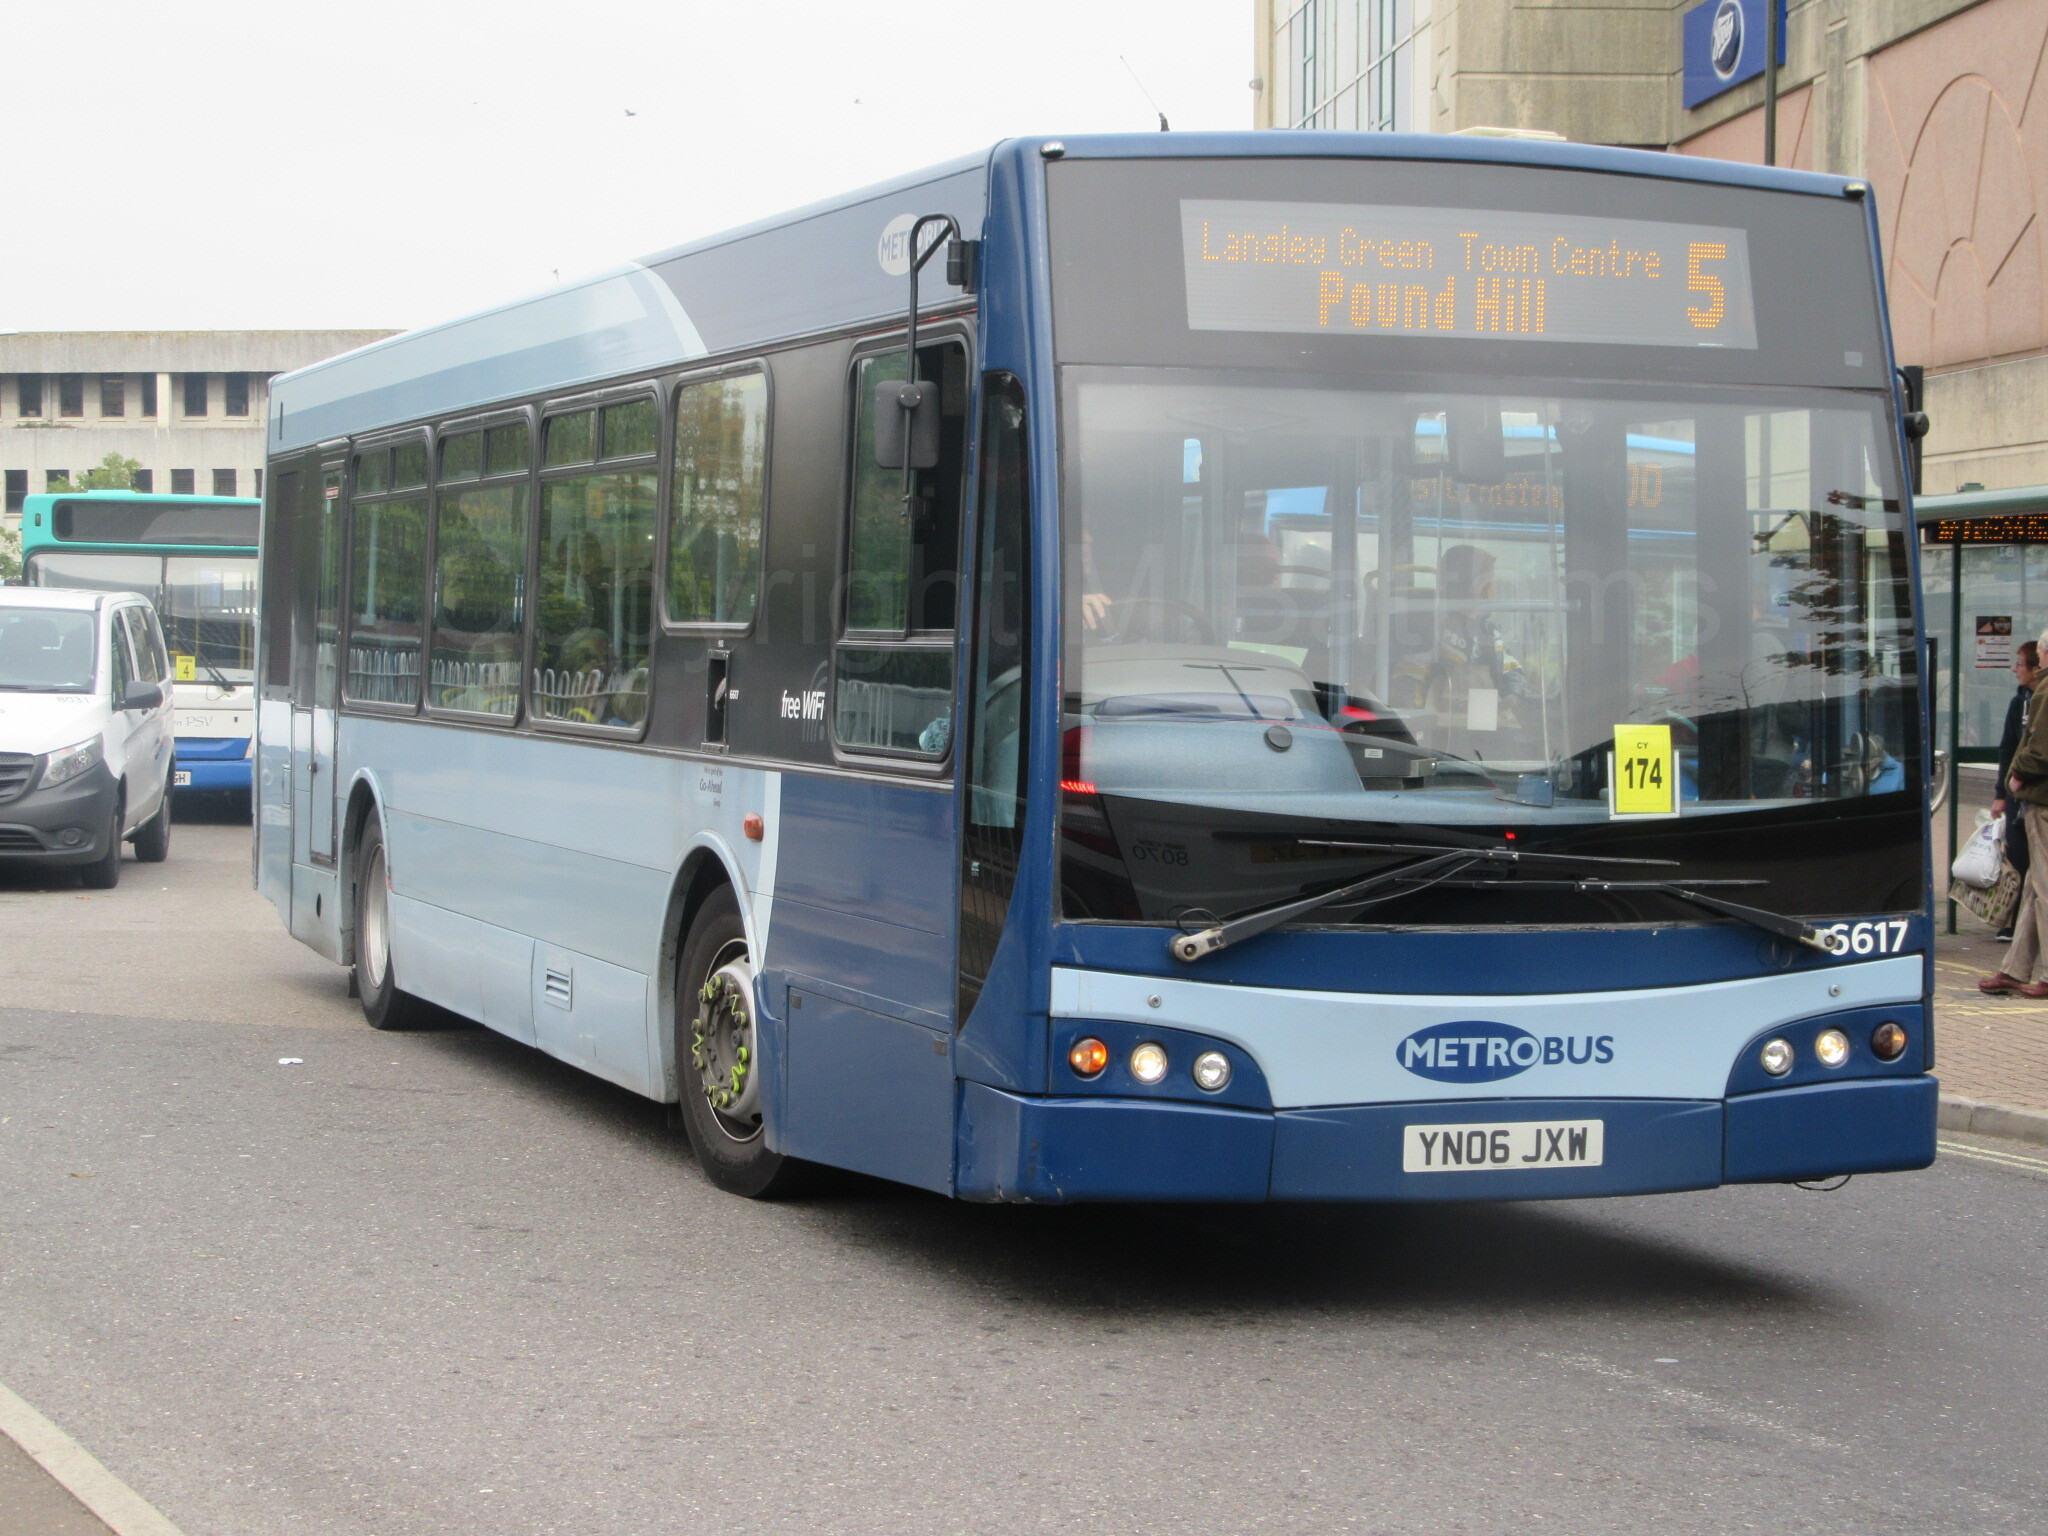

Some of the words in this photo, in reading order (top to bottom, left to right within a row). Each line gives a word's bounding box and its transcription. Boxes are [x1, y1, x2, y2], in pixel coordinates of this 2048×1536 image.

[1202, 221, 1326, 265] Langley
[1339, 227, 1434, 269] Green
[1459, 232, 1540, 273] Town
[1553, 236, 1662, 278] Centre
[1319, 270, 1455, 328] Pound
[1476, 276, 1546, 333] Hill
[1687, 242, 1727, 329] 5
[781, 689, 801, 720] free
[802, 690, 826, 721] WiFi
[1636, 741, 1649, 750] CY
[1624, 757, 1663, 790] 174
[1828, 920, 1909, 957] 6617
[1404, 1035, 1615, 1069] METROBUS
[1419, 1130, 1511, 1166] YN06
[1522, 1127, 1588, 1163] JXW
